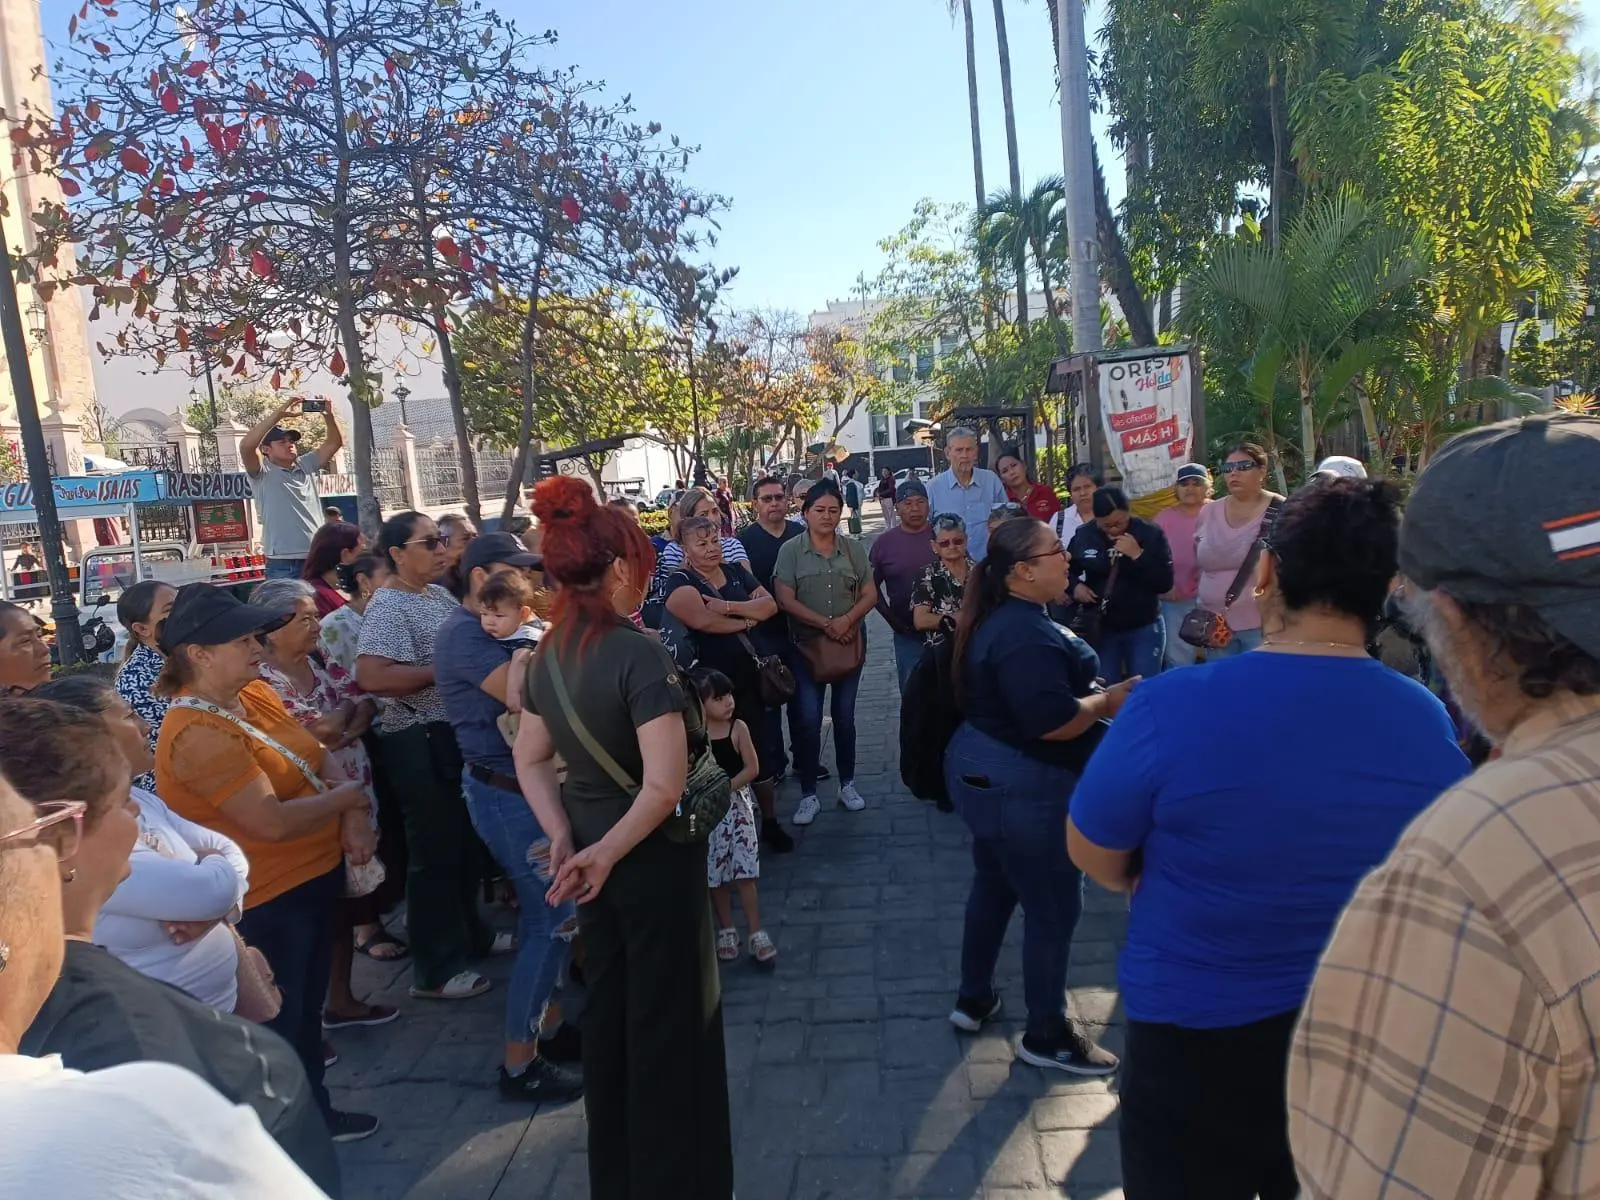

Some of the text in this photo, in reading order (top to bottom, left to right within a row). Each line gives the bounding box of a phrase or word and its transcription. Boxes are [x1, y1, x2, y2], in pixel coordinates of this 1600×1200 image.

[1129, 428, 1158, 445] MÁS
[3, 483, 36, 507] GU
[98, 479, 142, 502] ISAIAS
[167, 472, 254, 498] RASPADOS
